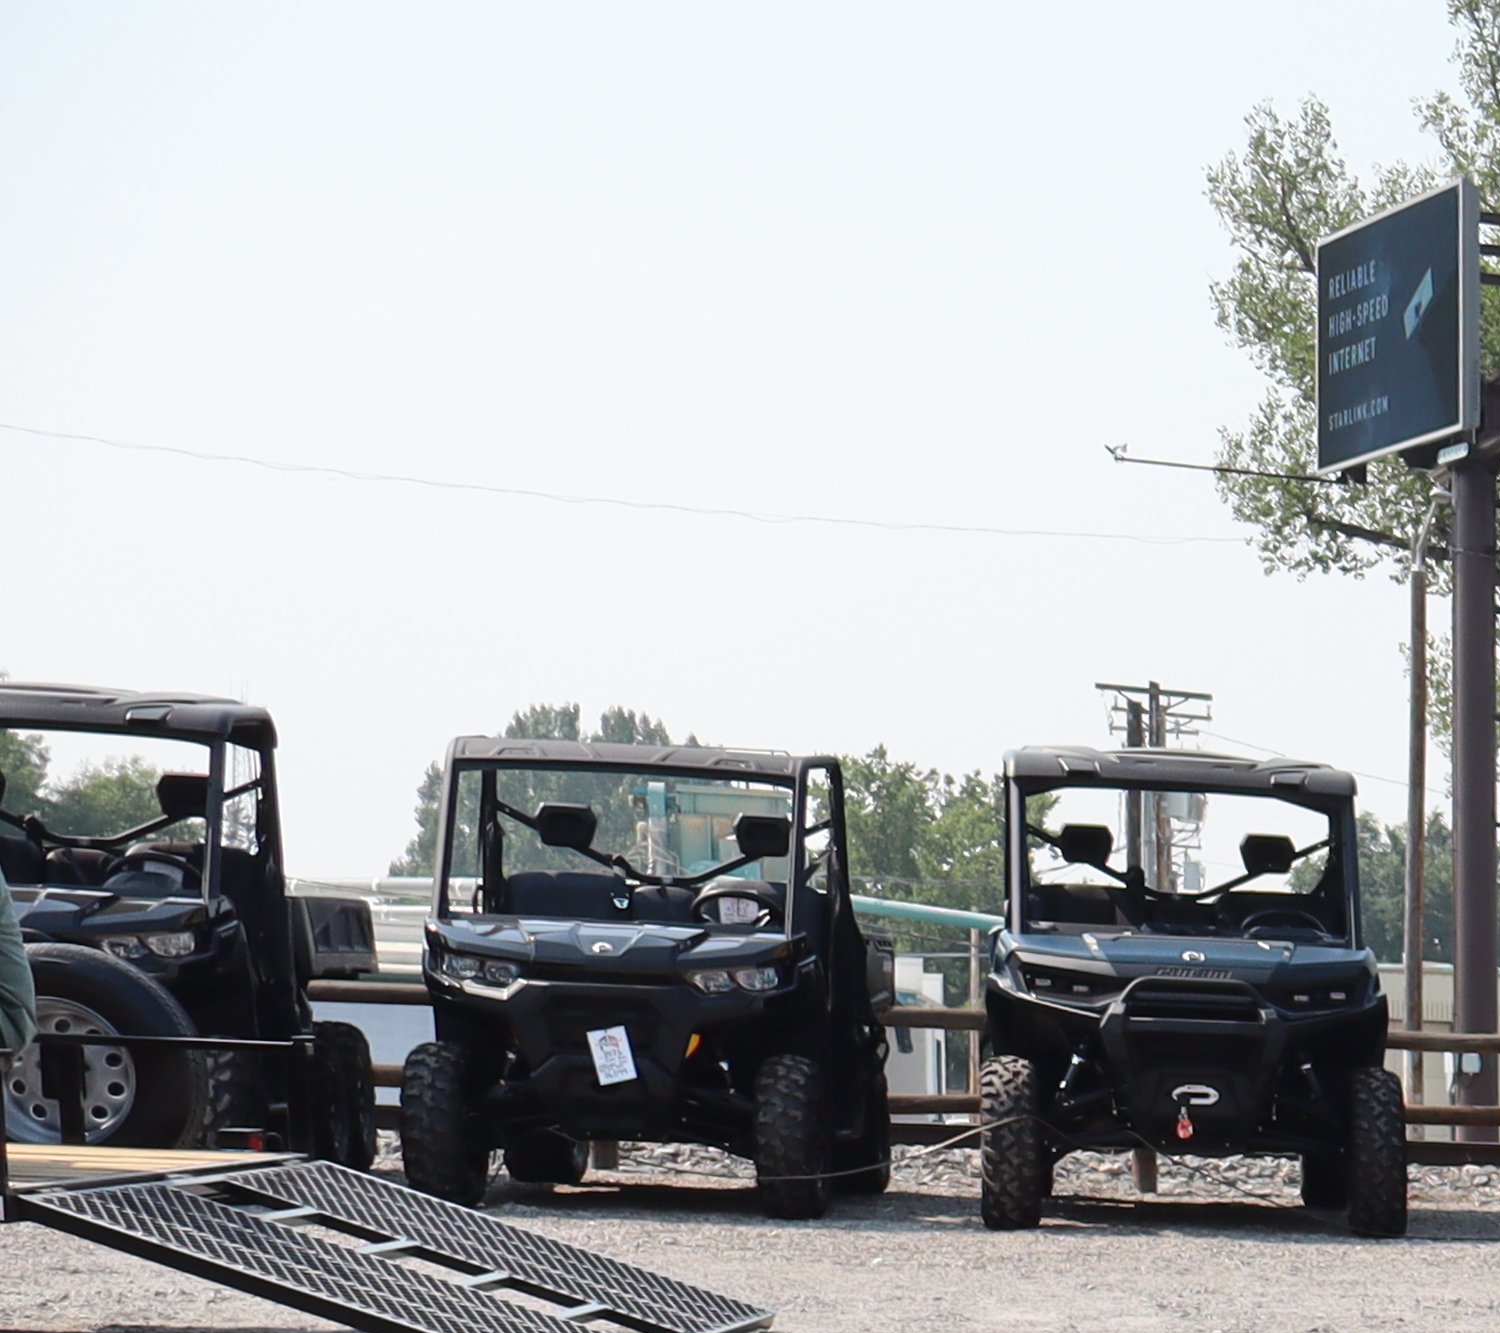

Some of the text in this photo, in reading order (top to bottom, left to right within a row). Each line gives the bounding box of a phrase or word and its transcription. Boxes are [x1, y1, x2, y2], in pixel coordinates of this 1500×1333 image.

[1328, 259, 1376, 299] RELIABLE
[1328, 294, 1389, 338] HIGH-SPEED
[1328, 336, 1377, 375] INTERNET
[1328, 396, 1389, 431] STARLINK.COM
